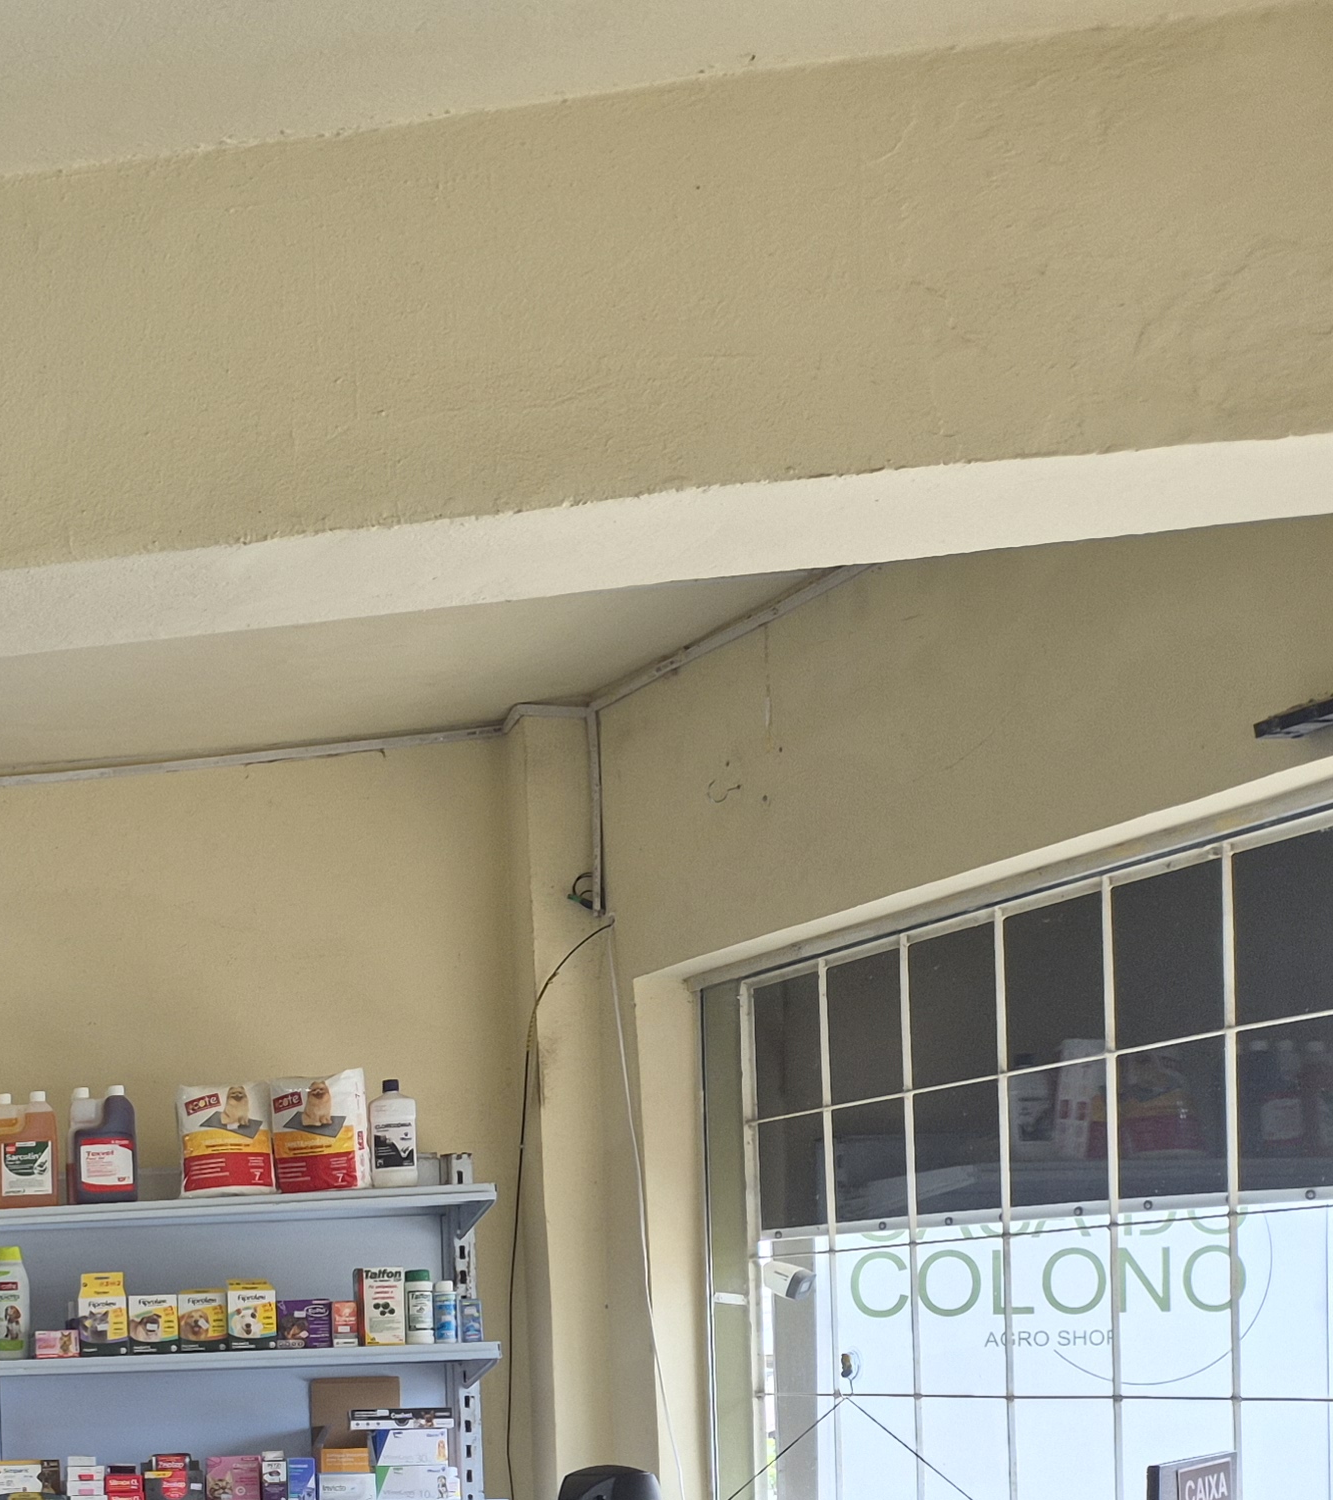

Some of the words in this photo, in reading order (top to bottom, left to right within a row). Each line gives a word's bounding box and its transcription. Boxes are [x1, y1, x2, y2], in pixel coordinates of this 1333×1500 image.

[254, 1172, 261, 1181] 7
[336, 1174, 343, 1183] 7
[849, 1244, 1247, 1319] COLONO
[984, 1331, 1050, 1349] AGRO
